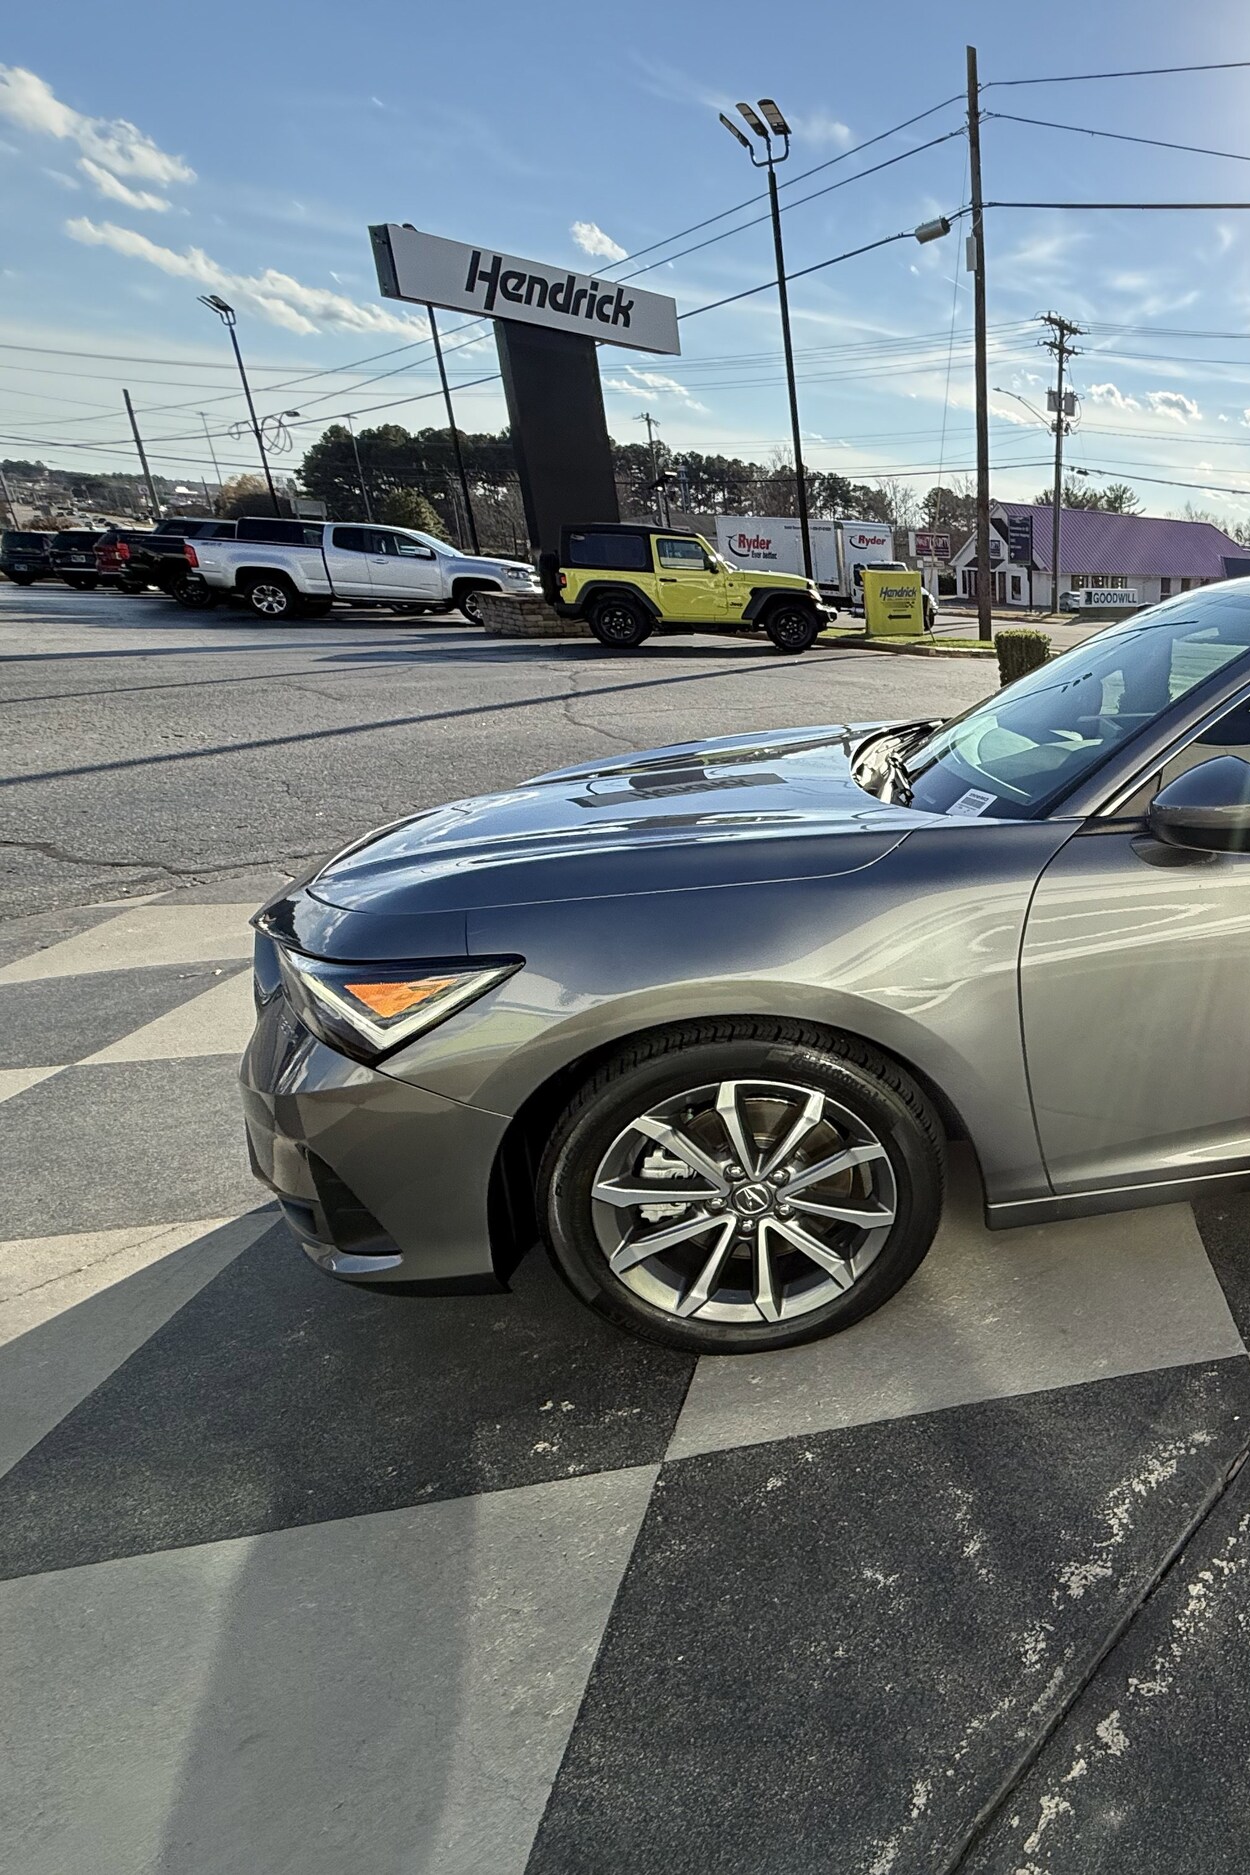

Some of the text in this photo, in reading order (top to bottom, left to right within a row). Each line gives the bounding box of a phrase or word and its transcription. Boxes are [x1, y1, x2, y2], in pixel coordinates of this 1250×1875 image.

[465, 250, 635, 328] Hendrick
[738, 533, 772, 552] Ryder
[859, 534, 886, 546] Ryder
[879, 586, 917, 601] Hendrick
[1093, 592, 1137, 604] GOODWILL
